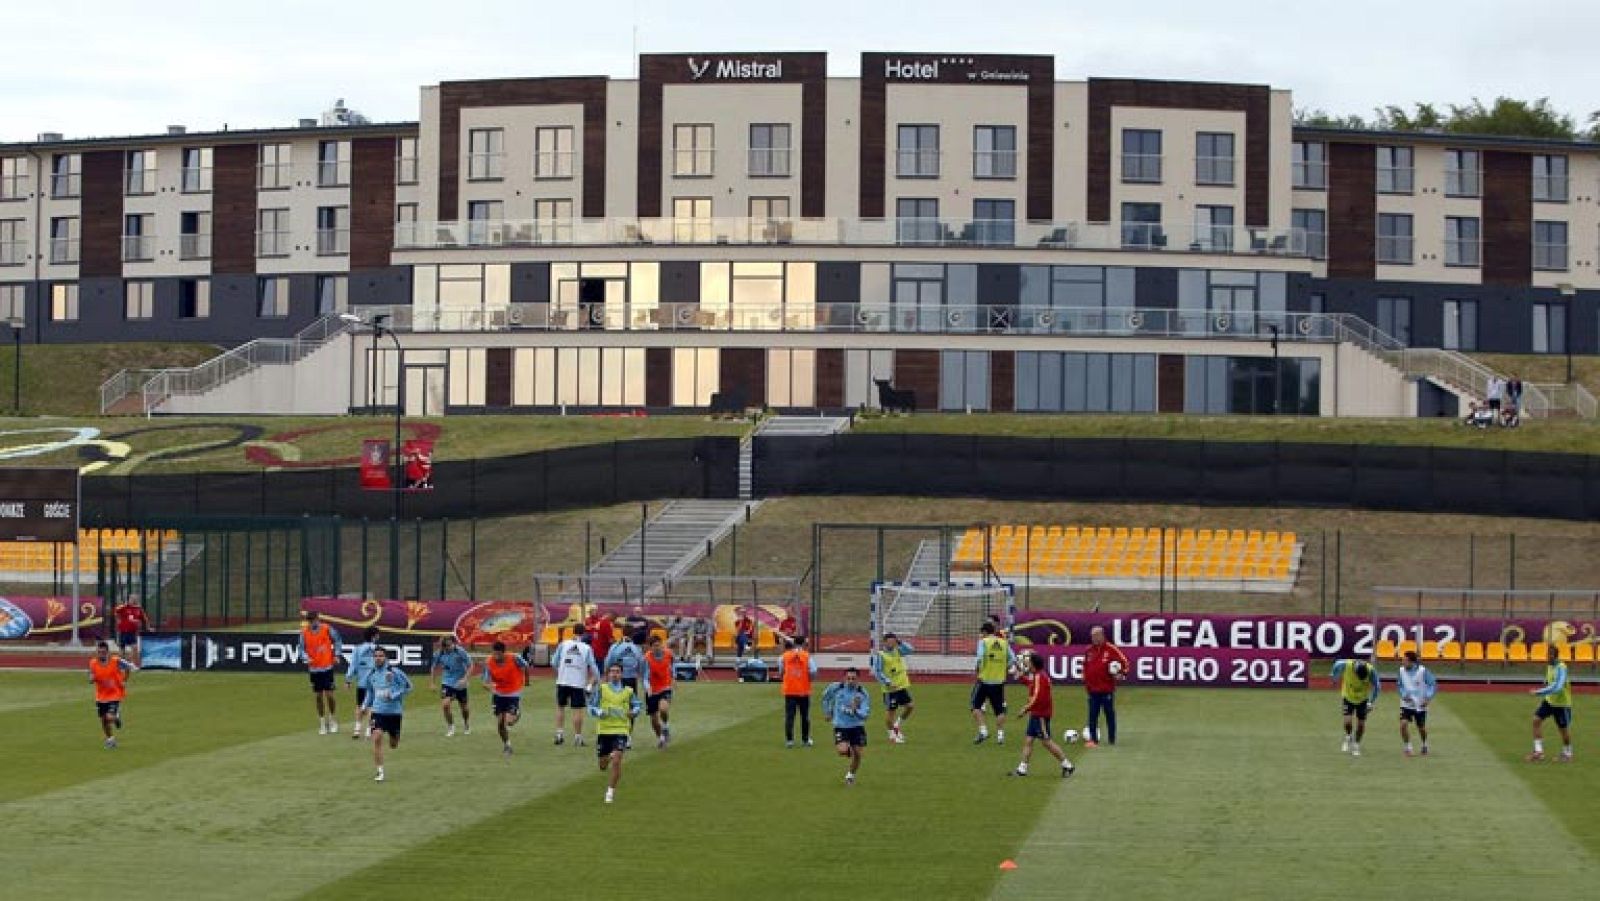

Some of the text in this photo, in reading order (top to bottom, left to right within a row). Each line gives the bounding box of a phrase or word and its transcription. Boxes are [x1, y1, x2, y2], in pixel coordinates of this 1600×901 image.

[716, 59, 783, 78] Mistral
[885, 59, 938, 78] Hotel
[1112, 618, 1219, 649] UEFA
[1230, 620, 1345, 654] EURO
[1136, 656, 1220, 681] EURO
[1230, 658, 1306, 683] 2012
